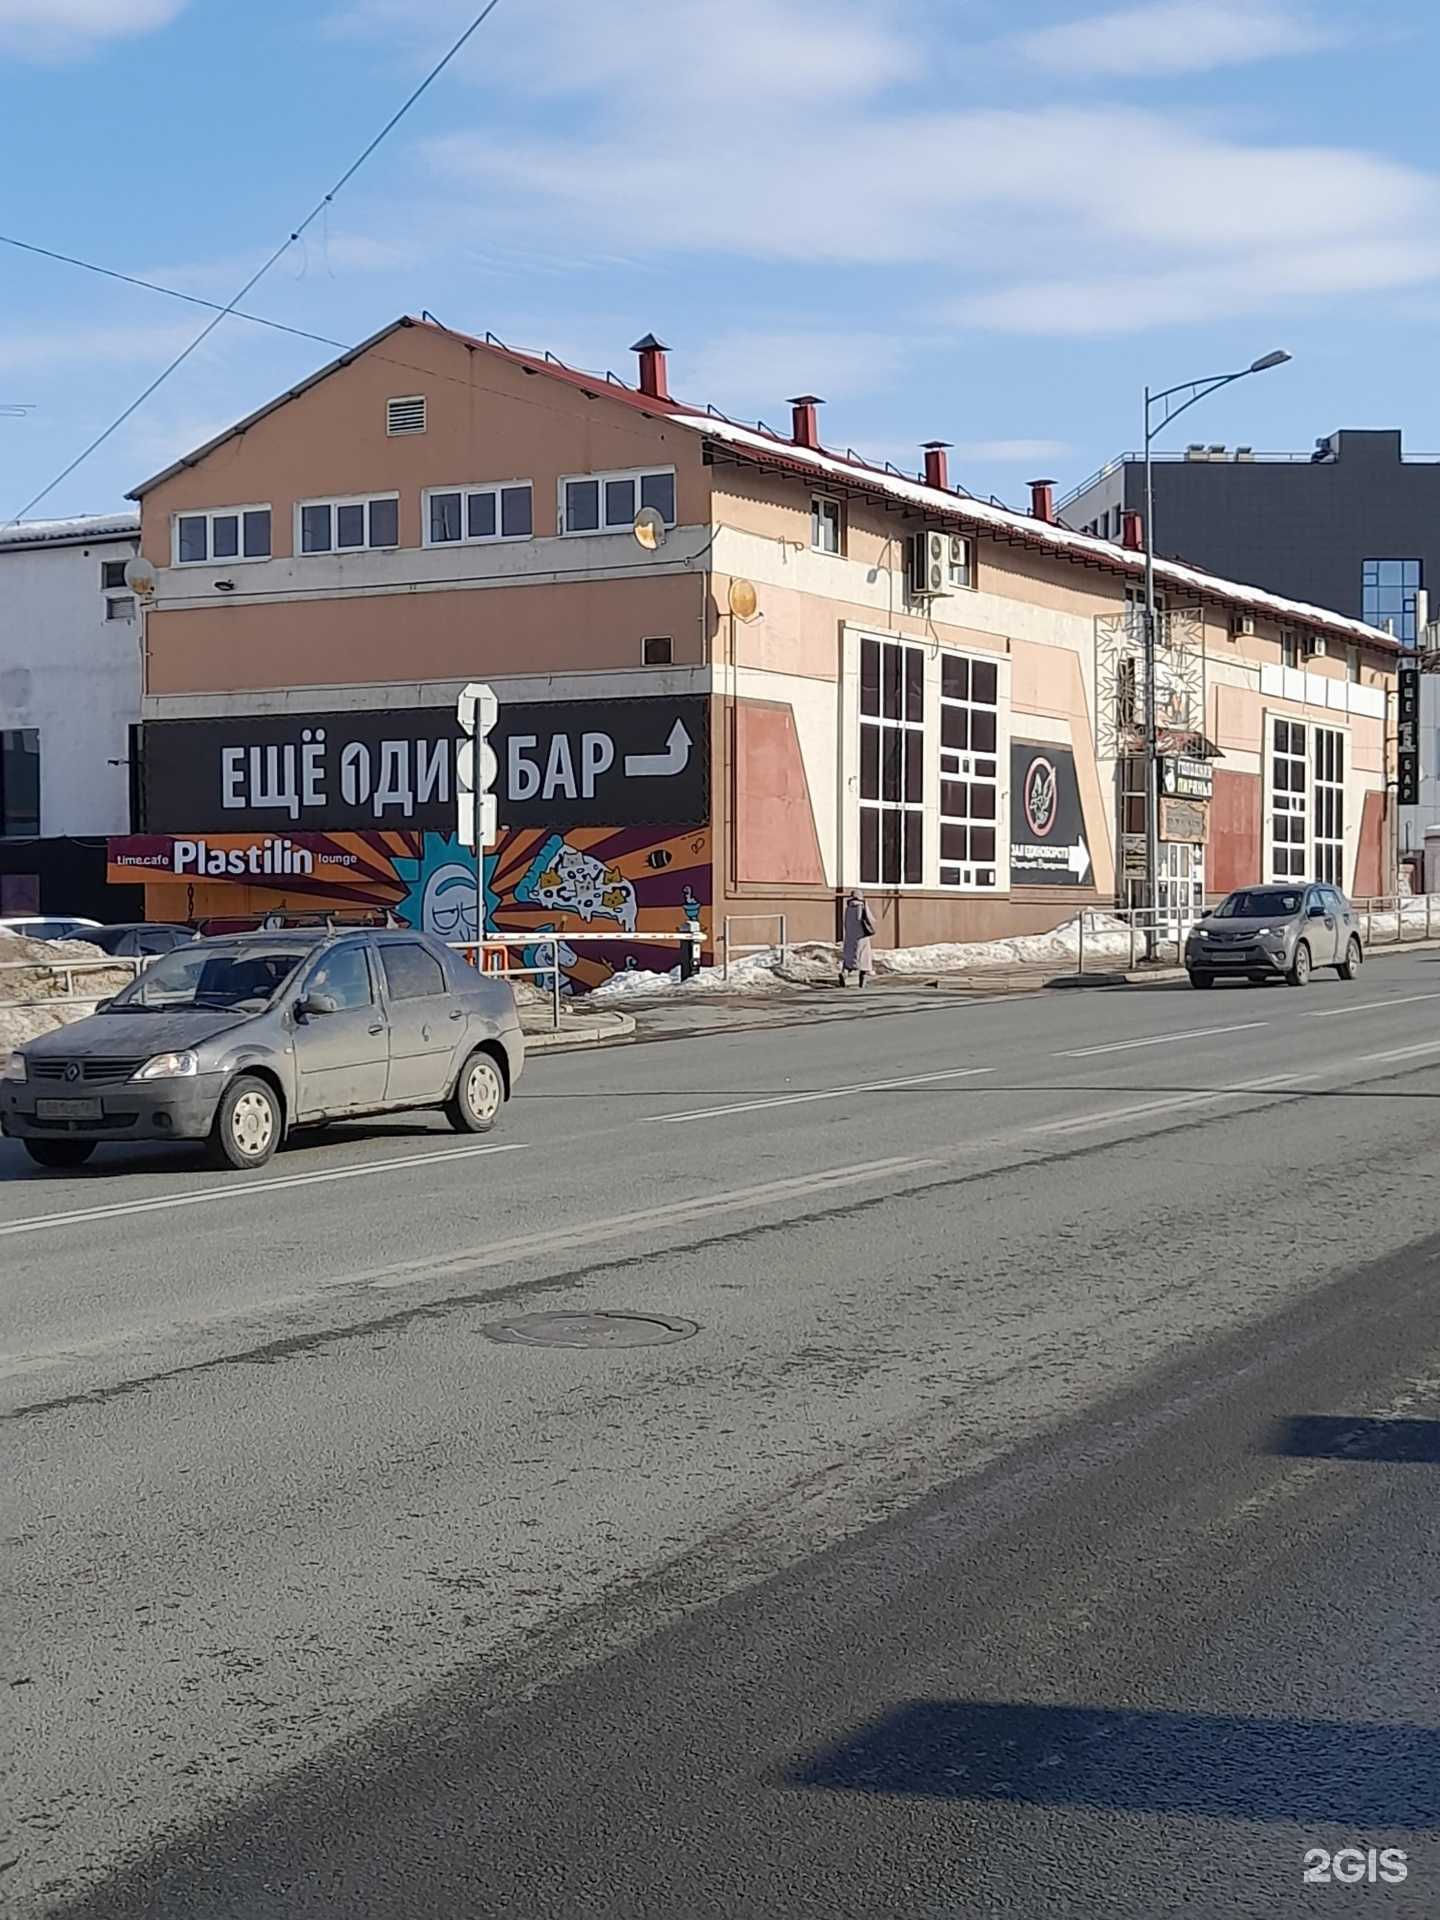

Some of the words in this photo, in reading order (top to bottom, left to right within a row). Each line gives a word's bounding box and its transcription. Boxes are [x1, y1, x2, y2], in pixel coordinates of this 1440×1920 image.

[221, 728, 327, 820] ЕЩЁ
[341, 737, 488, 817] ОДИ
[507, 732, 615, 801] БАР
[1403, 759, 1412, 800] БАР
[173, 839, 313, 875] Plastilin
[317, 852, 358, 867] lounge
